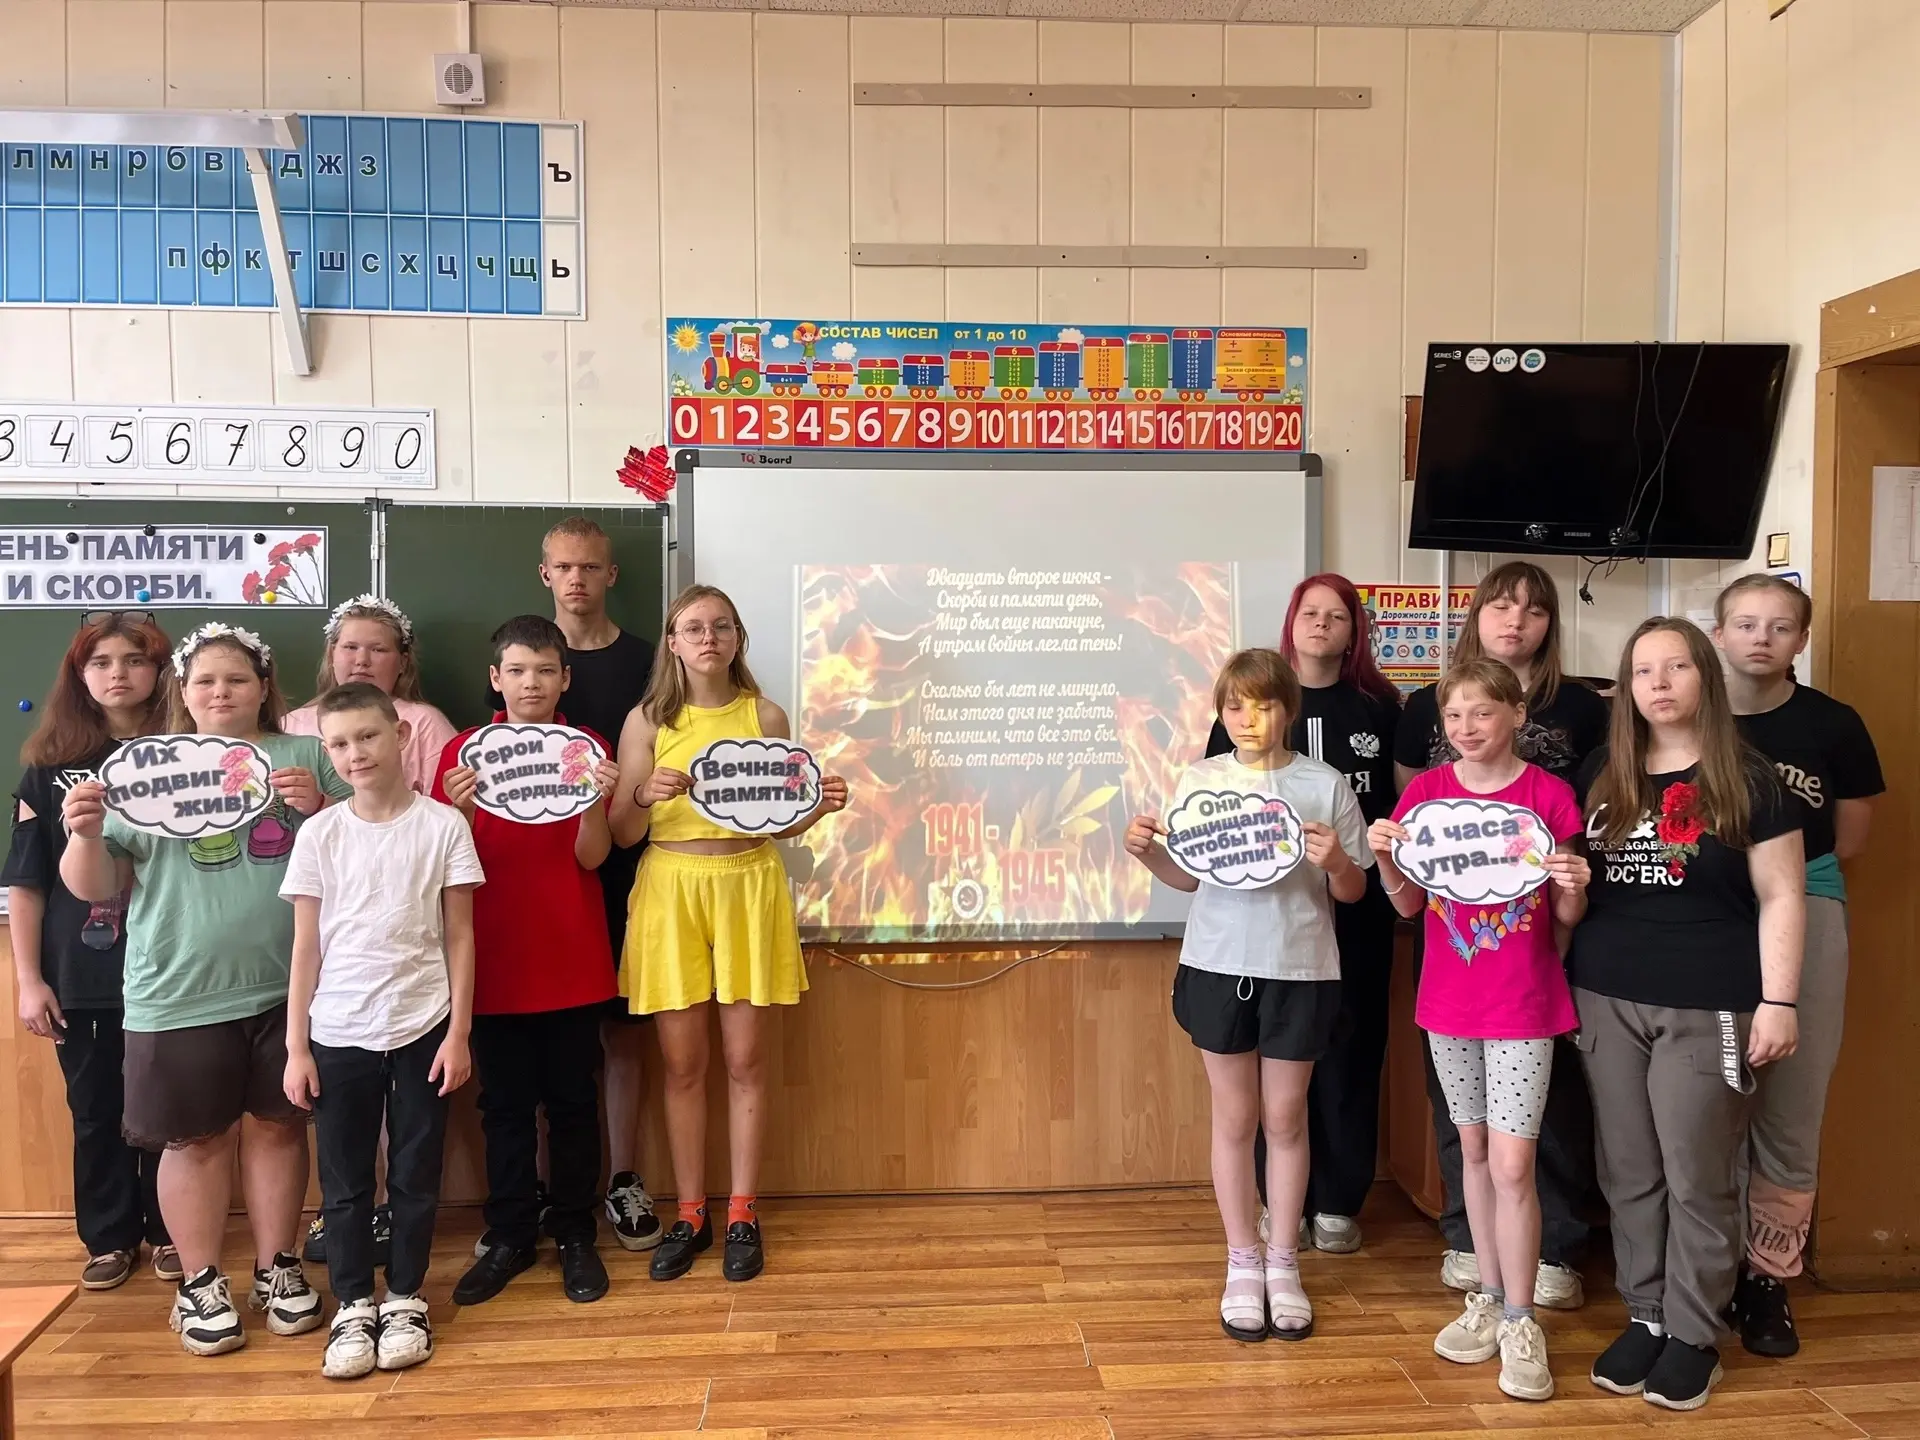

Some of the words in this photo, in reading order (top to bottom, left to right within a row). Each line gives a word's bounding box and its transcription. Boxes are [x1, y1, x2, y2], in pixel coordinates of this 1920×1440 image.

[13, 149, 33, 168] л
[50, 150, 73, 169] м
[90, 150, 109, 170] н
[128, 151, 148, 177] р
[167, 146, 187, 171] б
[205, 151, 224, 171] в
[280, 154, 303, 178] д
[316, 154, 342, 175] ж
[360, 155, 377, 176] з
[548, 163, 572, 183] ъ
[168, 247, 186, 268] п
[201, 242, 230, 276] ф
[245, 249, 262, 270] к
[319, 252, 346, 272] ш
[361, 253, 380, 274] с
[399, 254, 420, 274] х
[437, 255, 458, 280] ц
[476, 256, 495, 276] ч
[510, 257, 537, 282] щ
[552, 259, 571, 278] ь
[819, 326, 881, 339] СОСТАВ
[886, 327, 939, 339] ЧИСЕЛ
[954, 330, 969, 339] от
[974, 329, 982, 340] 1
[987, 330, 1004, 341] до
[1010, 329, 1027, 340] 10
[1146, 334, 1152, 342] 9
[967, 351, 973, 360] 5
[1011, 347, 1018, 355] 6
[1056, 343, 1062, 351] 7
[784, 365, 789, 373] 1
[829, 363, 836, 371] 2
[876, 359, 882, 368] 3
[920, 356, 927, 364] 4
[674, 405, 698, 439] 0
[710, 405, 725, 440] 1
[736, 405, 760, 440] 2
[767, 405, 790, 441] 3
[796, 406, 822, 441] 4
[828, 407, 851, 442] 5
[857, 407, 882, 443] 6
[888, 408, 911, 443] 7
[917, 408, 942, 443] 8
[949, 408, 972, 443] 9
[976, 409, 1004, 444] 10
[1008, 409, 1033, 444] 11
[1037, 409, 1064, 444] 12
[1067, 410, 1094, 444] 13
[1096, 410, 1124, 444] 14
[1127, 410, 1154, 444] 15
[1156, 410, 1184, 445] 16
[1186, 411, 1213, 445] 17
[1215, 411, 1243, 445] 18
[1245, 411, 1273, 445] 19
[1274, 411, 1301, 446] 20
[50, 420, 75, 463] 4
[106, 421, 133, 463] 5
[166, 422, 191, 465] 6
[225, 424, 249, 466] 7
[283, 425, 307, 467] 8
[339, 426, 365, 468] 9
[395, 427, 421, 470] 0
[759, 455, 793, 464] Board
[0, 535, 69, 561] ЕНЬ
[83, 535, 243, 561] ПАМЯТИ
[8, 574, 32, 600] И
[46, 574, 212, 600] СКОРБИ.
[926, 567, 1005, 591] Двадцать
[1007, 567, 1060, 590] второе
[1062, 571, 1101, 585] июня
[937, 589, 987, 613] Скорби
[990, 594, 999, 608] и
[1000, 594, 1064, 608] памяти
[1066, 594, 1103, 612] день,
[935, 612, 967, 635] Мир
[970, 612, 1000, 631] был
[1001, 617, 1030, 634] еще
[1031, 616, 1105, 635] накануне,
[1382, 611, 1427, 620] Дорожного
[918, 634, 932, 656] А
[934, 639, 986, 659] утром
[988, 634, 1033, 653] войны
[1035, 638, 1077, 652] легла
[1080, 633, 1123, 652] тень!
[921, 679, 981, 699] Сколько
[984, 679, 1004, 698] бы
[1005, 684, 1036, 698] лет
[1038, 683, 1056, 697] не
[922, 702, 958, 724] Нам
[960, 707, 1004, 721] этого
[1007, 706, 1034, 726] дня
[1037, 706, 1054, 720] не
[906, 725, 932, 745] Мы
[1004, 729, 1034, 743] что
[1037, 723, 1060, 743] все
[1061, 728, 1091, 742] это
[131, 745, 181, 769] Их
[467, 739, 544, 771] Герои
[912, 749, 927, 768] И
[929, 749, 963, 768] боль
[966, 753, 988, 767] от
[990, 752, 1044, 771] потерь
[1046, 752, 1064, 766] не
[476, 780, 489, 794] в
[491, 762, 560, 785] наших
[701, 760, 800, 780] Вечная
[108, 769, 226, 804] подвиг
[495, 783, 588, 804] сердцах!
[704, 783, 806, 805] память!
[173, 790, 252, 818] жив!
[1199, 797, 1241, 816] Они
[1168, 811, 1286, 846] защищали,
[1416, 825, 1435, 848] 4
[1443, 819, 1520, 841] часа
[1182, 832, 1248, 857] чтобы
[1254, 828, 1289, 843] мы
[1208, 843, 1275, 870] жили!
[1418, 851, 1518, 881] утра...
[1605, 853, 1648, 862] MILANO
[1000, 848, 1066, 904] 1945
[1718, 1011, 1736, 1047] COULD
[1723, 1054, 1737, 1068] ME
[1727, 1069, 1742, 1092] OLD
